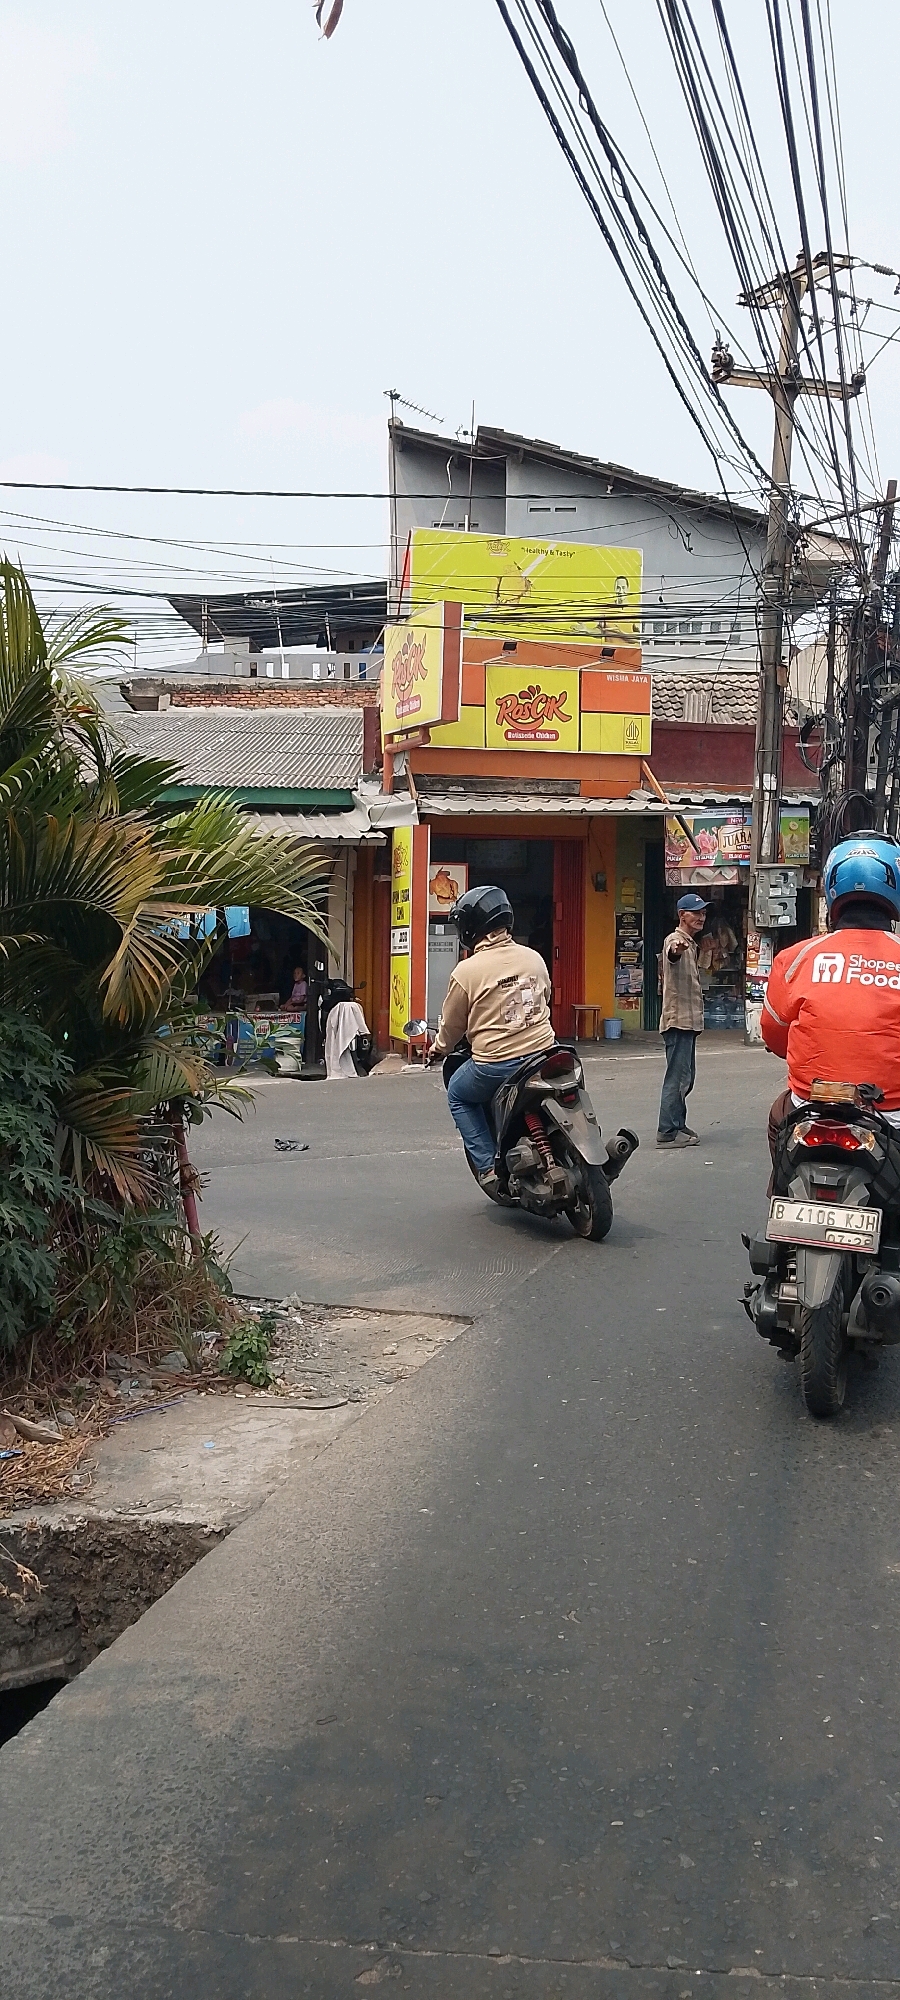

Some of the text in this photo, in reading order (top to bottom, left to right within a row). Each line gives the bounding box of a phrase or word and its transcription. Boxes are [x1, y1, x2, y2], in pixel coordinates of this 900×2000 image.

[631, 675, 648, 683] JAYA
[535, 731, 556, 739] Chicken
[775, 1204, 785, 1220] B
[795, 1207, 836, 1226] 4106
[845, 1213, 876, 1232] KJH
